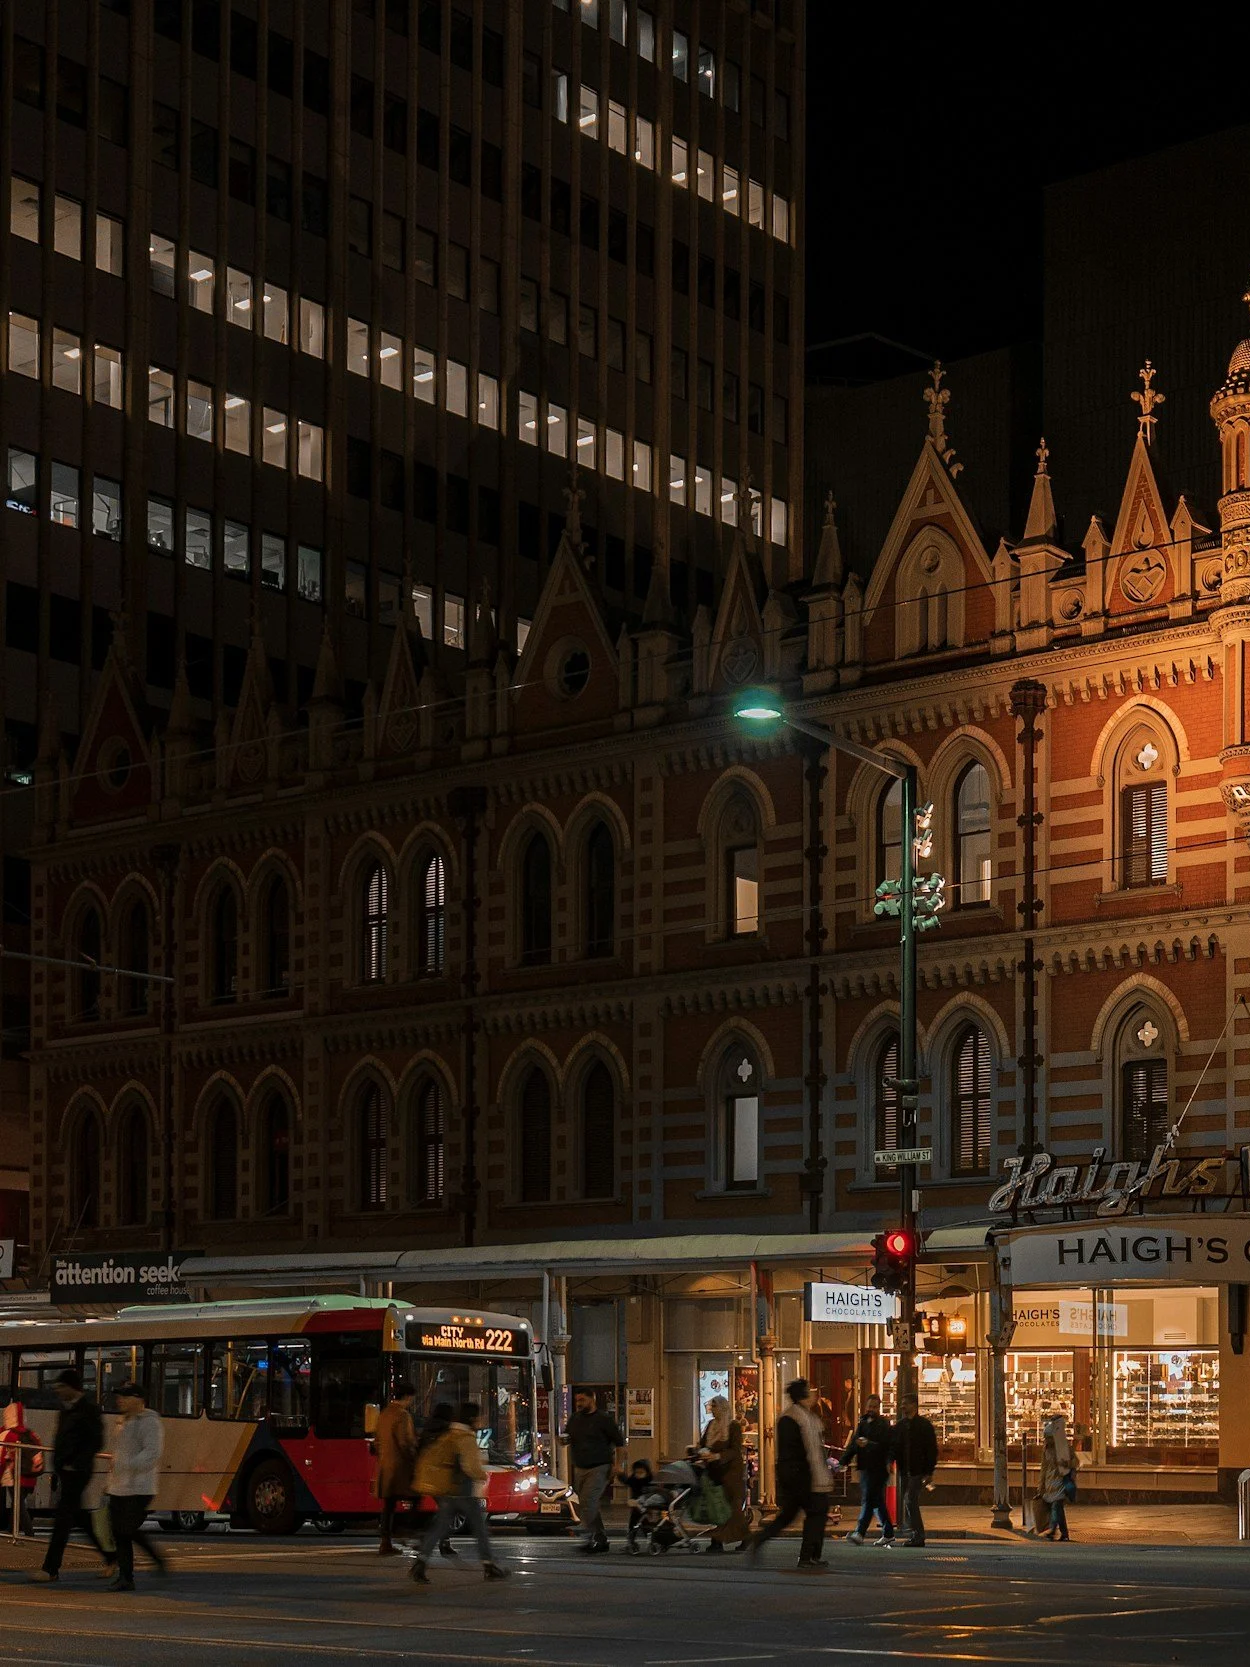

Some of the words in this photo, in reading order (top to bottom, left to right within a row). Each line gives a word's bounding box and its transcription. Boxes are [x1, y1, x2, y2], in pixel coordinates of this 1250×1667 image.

[882, 1153, 896, 1161] KING
[922, 1151, 929, 1160] ST
[1057, 1237, 1229, 1266] HAIGH'S
[55, 1258, 135, 1285] attention
[139, 1255, 181, 1283] seek
[146, 1284, 169, 1296] coffee
[826, 1291, 882, 1307] HAIGH'S
[825, 1307, 882, 1317] CHOCOLATES
[422, 1335, 433, 1346] via
[434, 1335, 452, 1347] Main
[452, 1337, 474, 1349] North
[474, 1338, 485, 1350] Rd
[440, 1325, 464, 1338] CITY
[485, 1328, 512, 1352] 222
